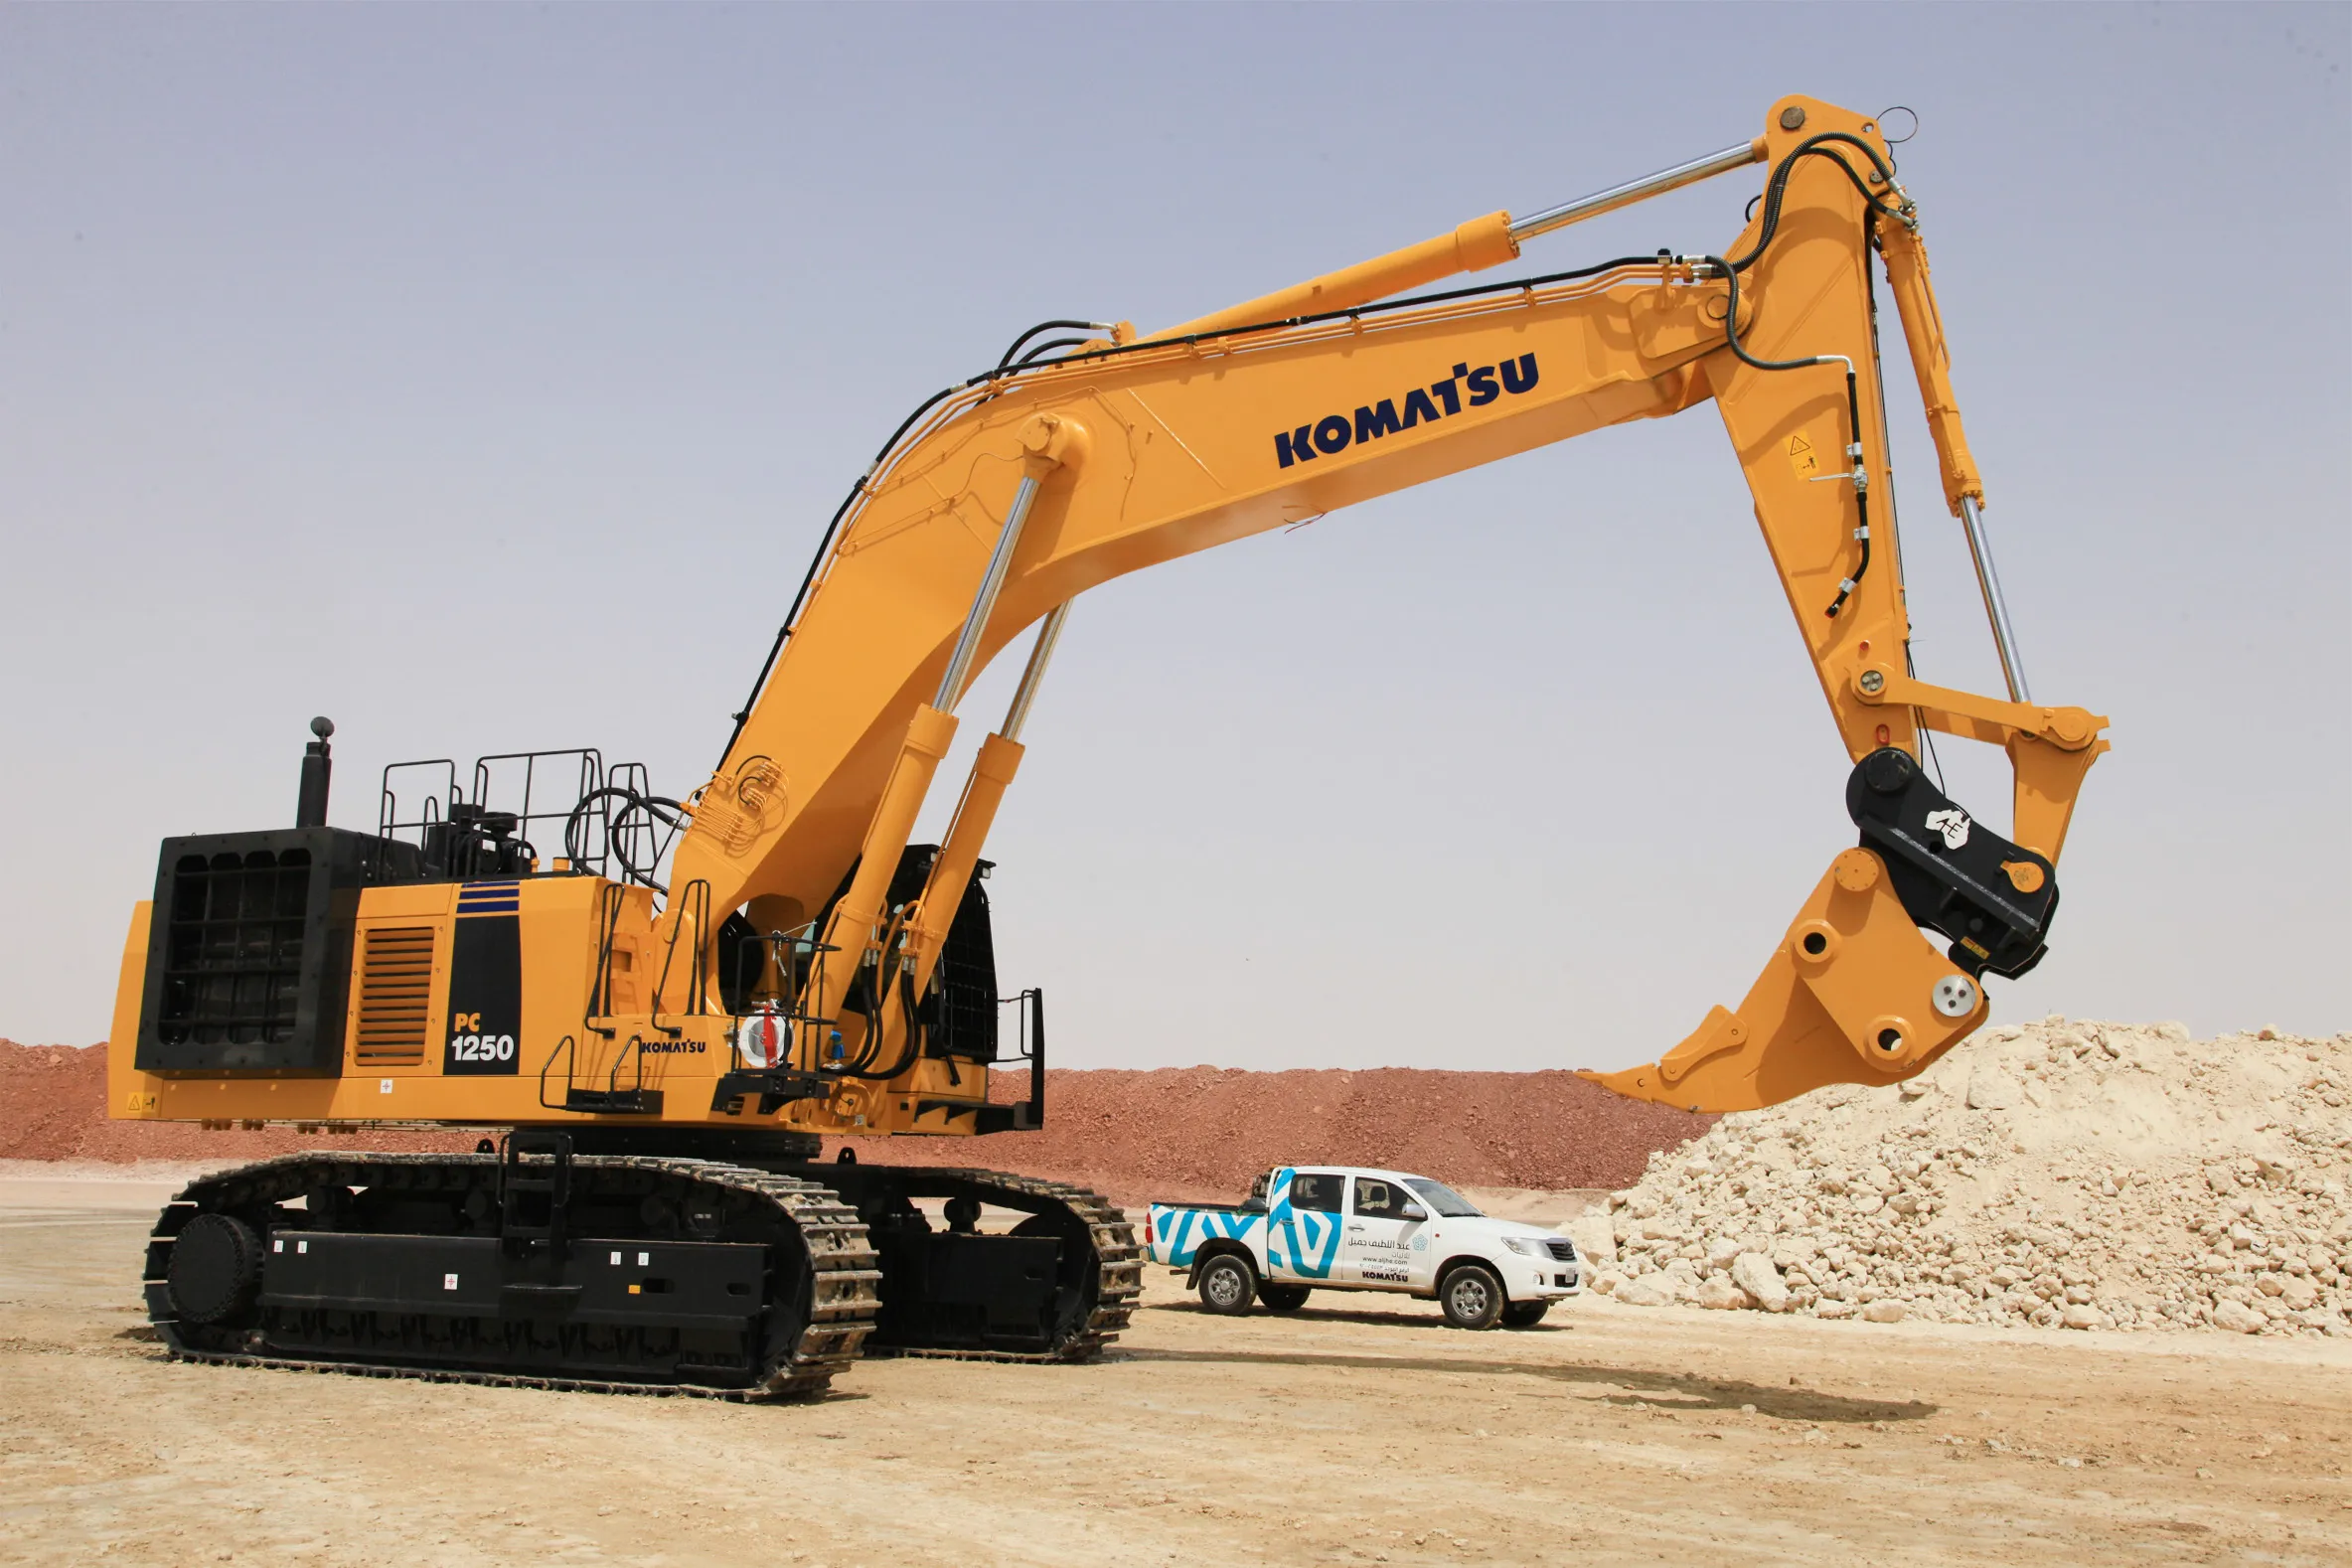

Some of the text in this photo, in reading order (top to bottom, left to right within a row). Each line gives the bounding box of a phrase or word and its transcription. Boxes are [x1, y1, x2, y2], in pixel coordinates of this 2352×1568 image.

[1274, 352, 1539, 469] KOMATSU
[453, 1013, 481, 1032] PC
[451, 1034, 514, 1061] 1250
[642, 1038, 706, 1053] KOMATSU
[1362, 1271, 1408, 1282] KOMATSU
